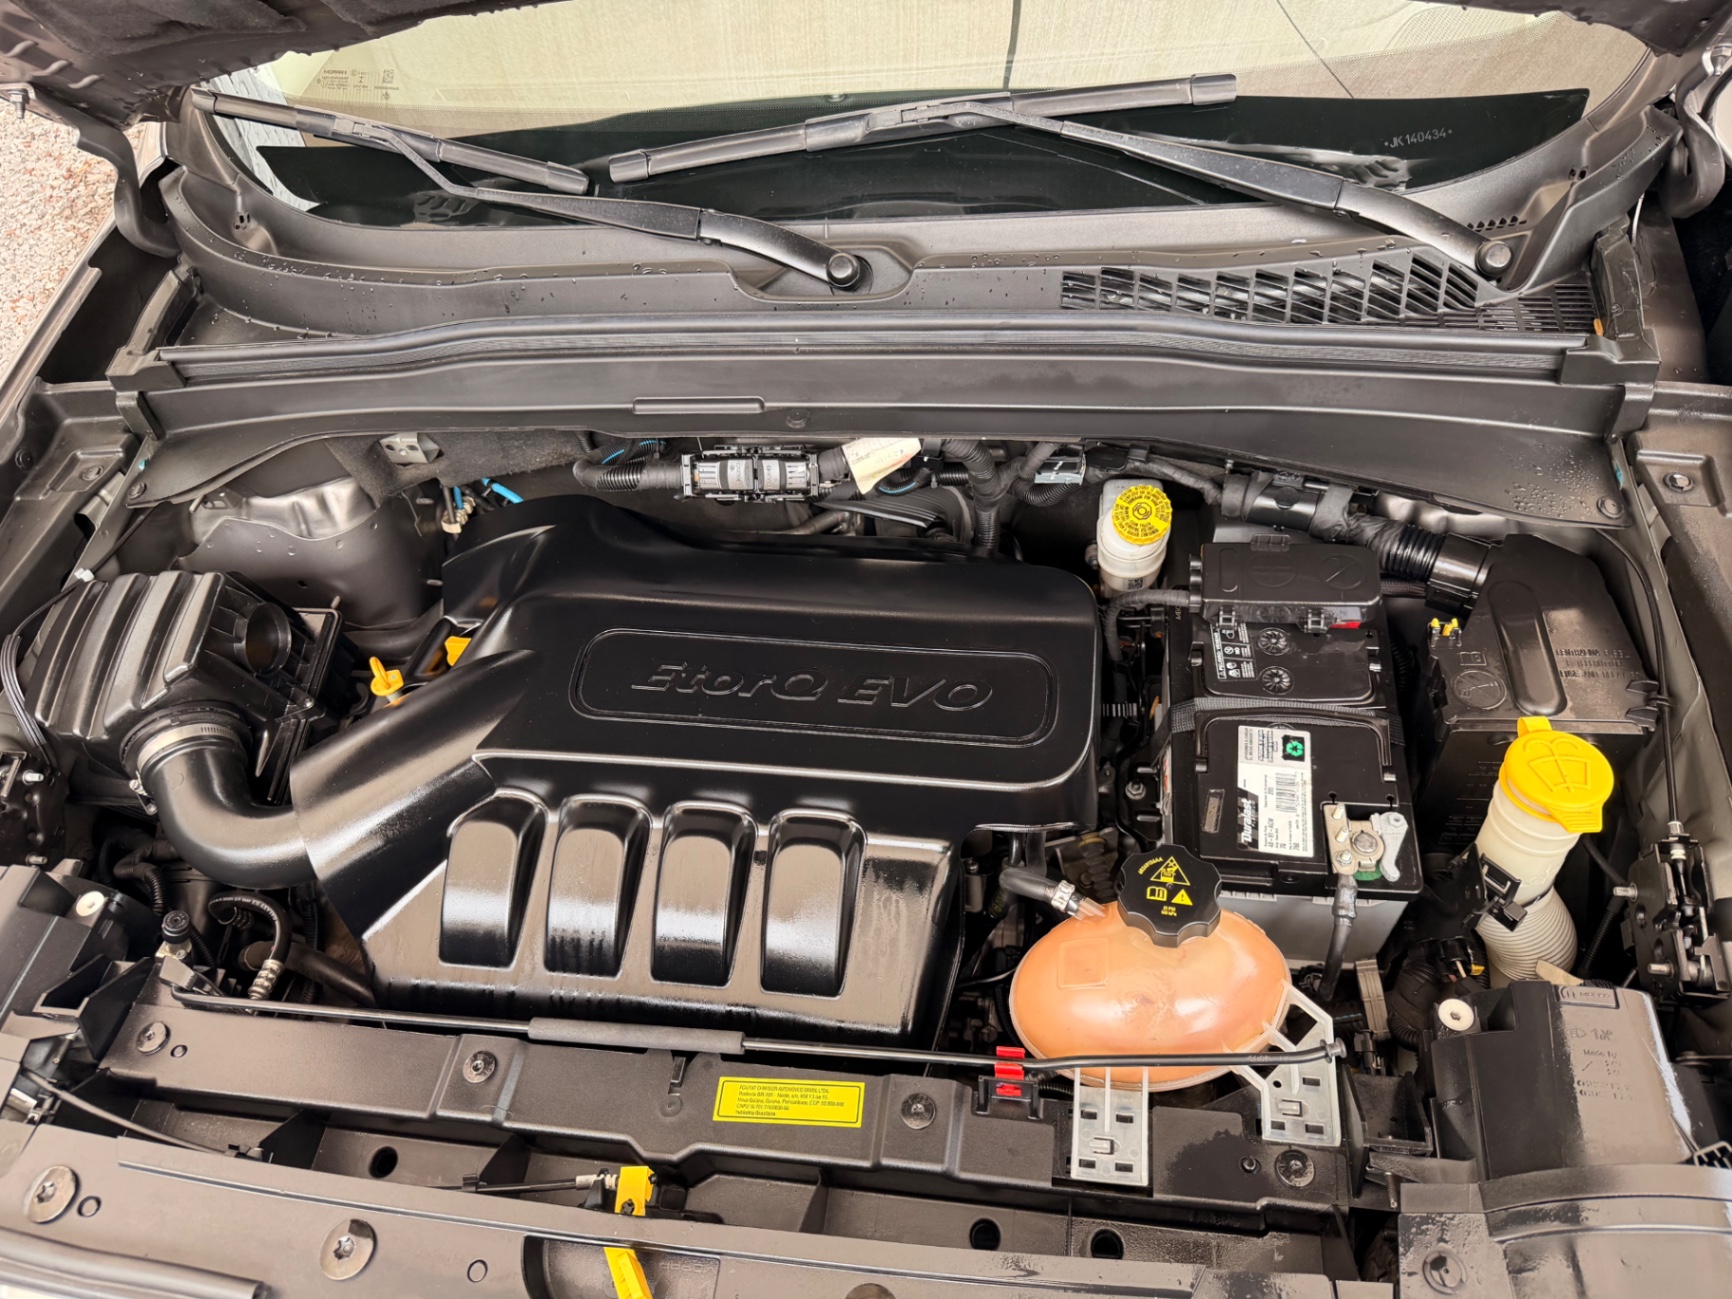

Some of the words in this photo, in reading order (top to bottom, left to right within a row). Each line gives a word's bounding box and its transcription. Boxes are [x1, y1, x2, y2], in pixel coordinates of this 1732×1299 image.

[631, 662, 828, 701] EtorQ
[837, 675, 993, 712] EVO
[1240, 798, 1252, 843] Duralast
